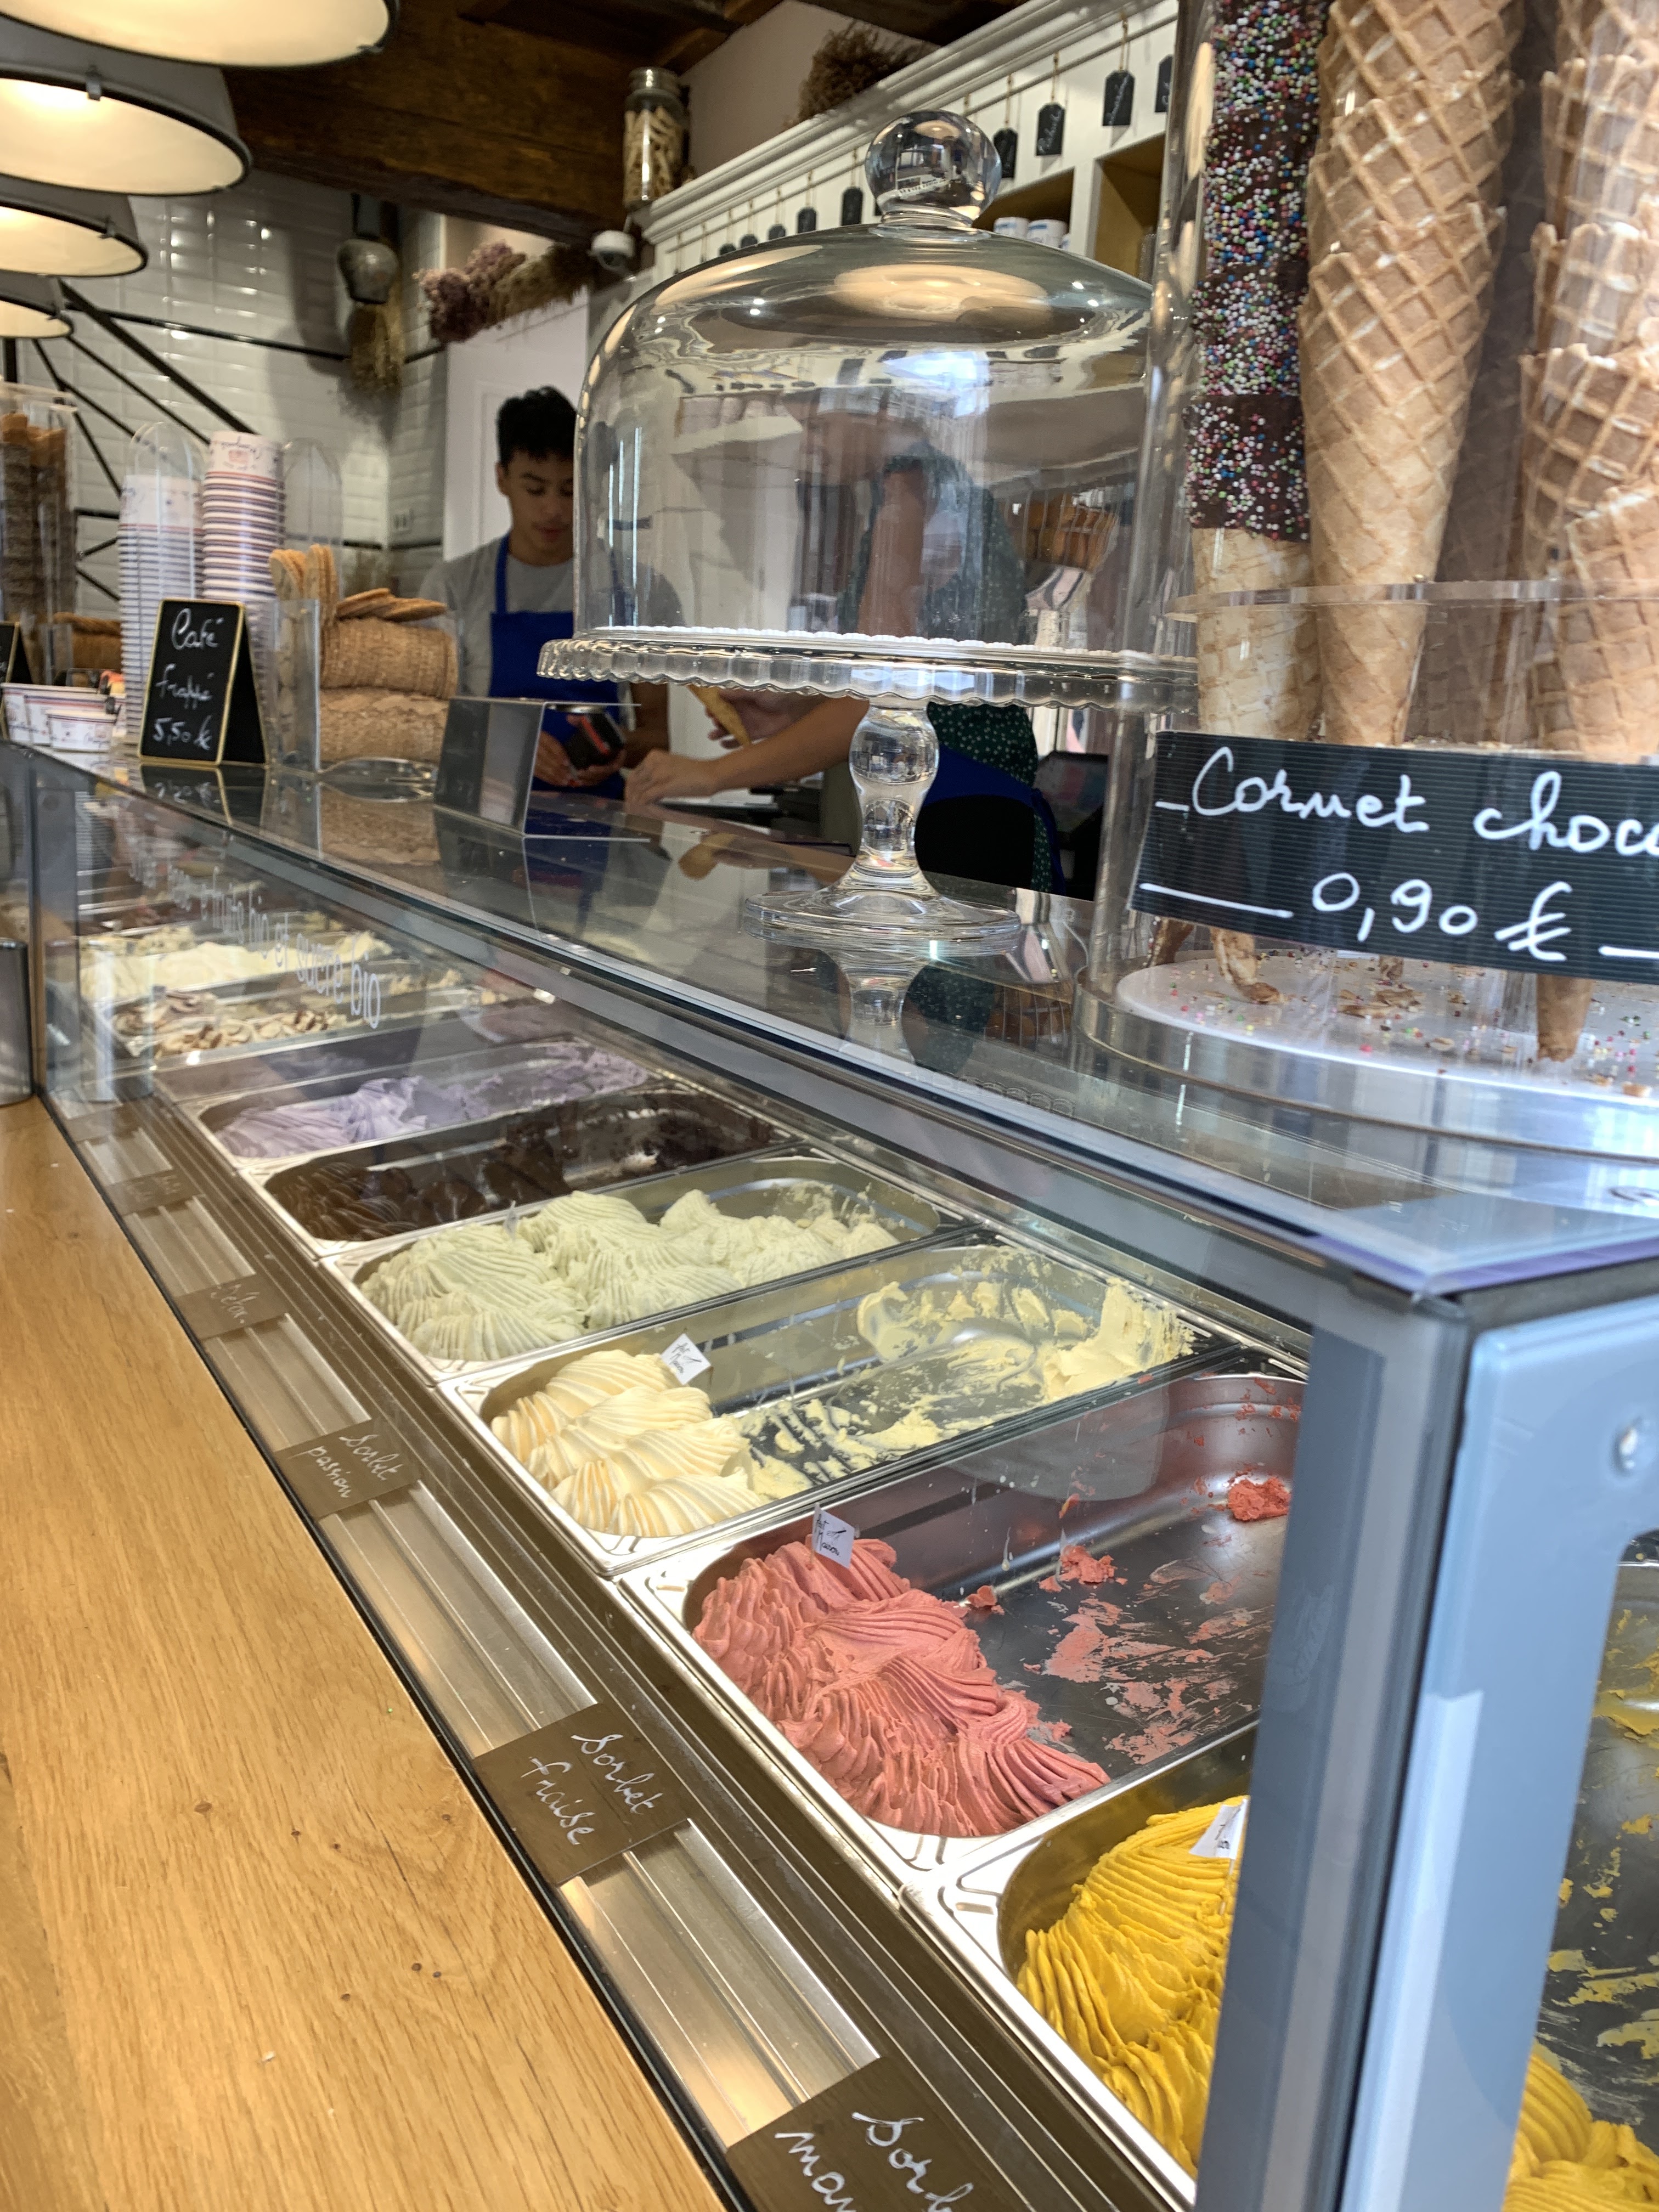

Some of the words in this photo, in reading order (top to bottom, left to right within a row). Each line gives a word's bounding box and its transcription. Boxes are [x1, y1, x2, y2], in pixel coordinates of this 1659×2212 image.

[171, 607, 225, 650] Café
[1192, 746, 1430, 832] Cornet
[349, 936, 381, 1029] bio
[286, 1446, 352, 1498] passion
[338, 1434, 403, 1481] Sorbet
[520, 1756, 596, 1846] fraise
[570, 1734, 663, 1815] Sorbet
